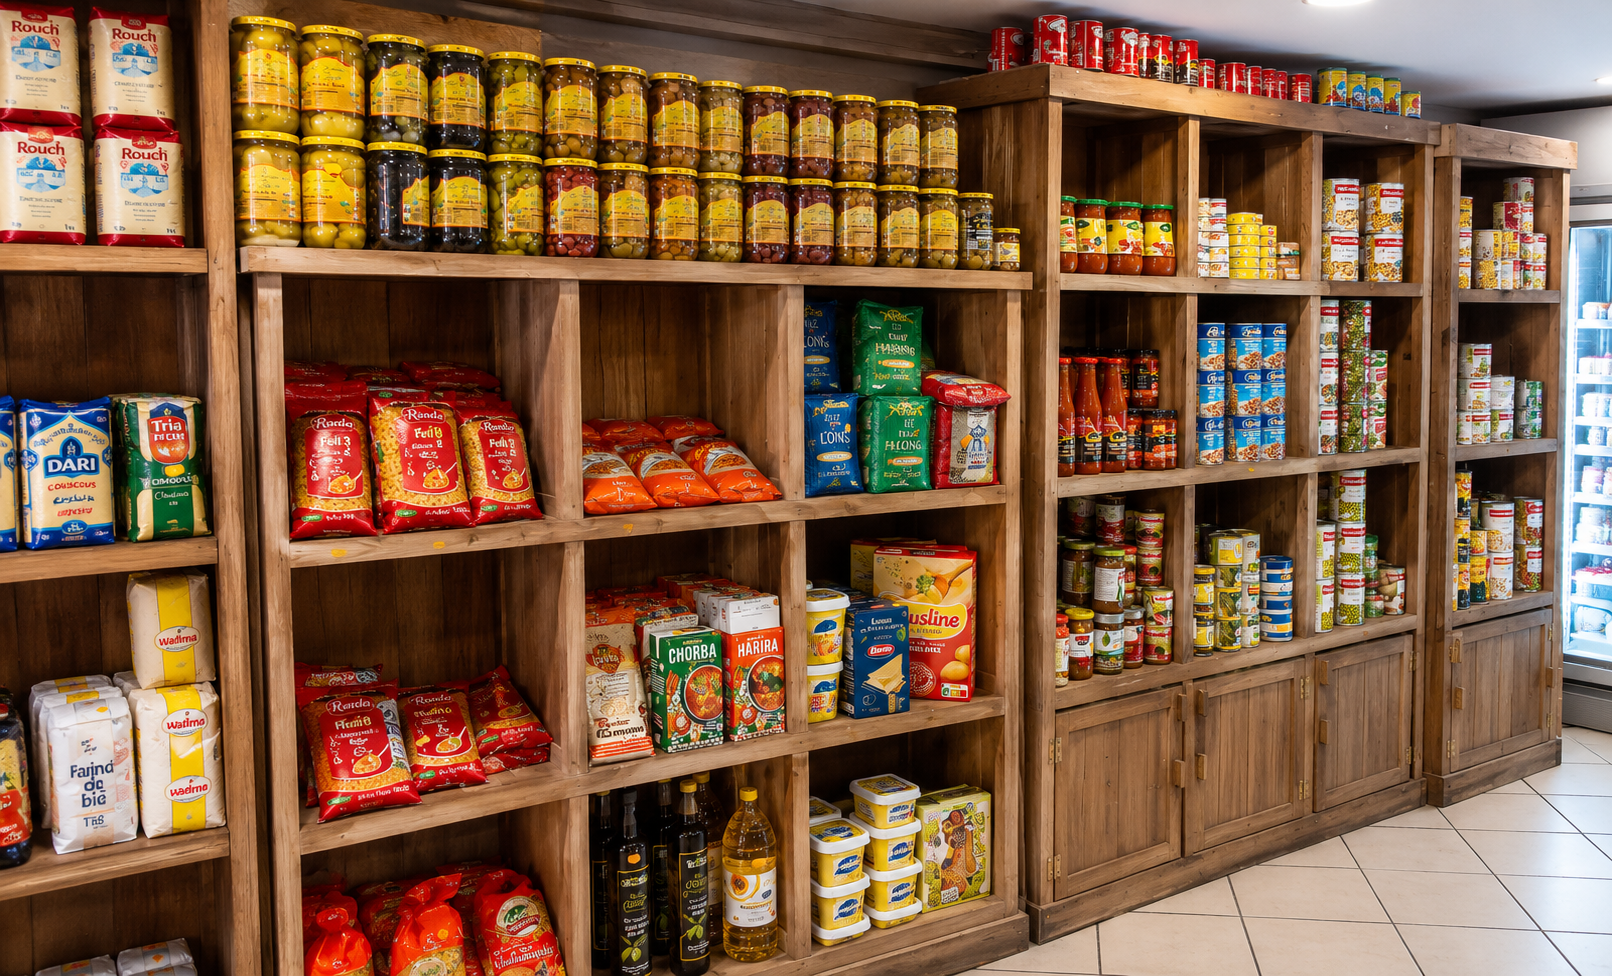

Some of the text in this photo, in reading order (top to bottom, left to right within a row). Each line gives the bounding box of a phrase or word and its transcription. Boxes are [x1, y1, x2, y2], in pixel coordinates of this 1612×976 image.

[11, 20, 60, 35] Rouch
[112, 28, 157, 42] Rouch
[17, 141, 65, 156] Rouch
[121, 147, 168, 161] Rouch
[47, 457, 96, 473] DARI
[668, 643, 717, 664] CHORBA
[737, 638, 779, 658] HARIRA
